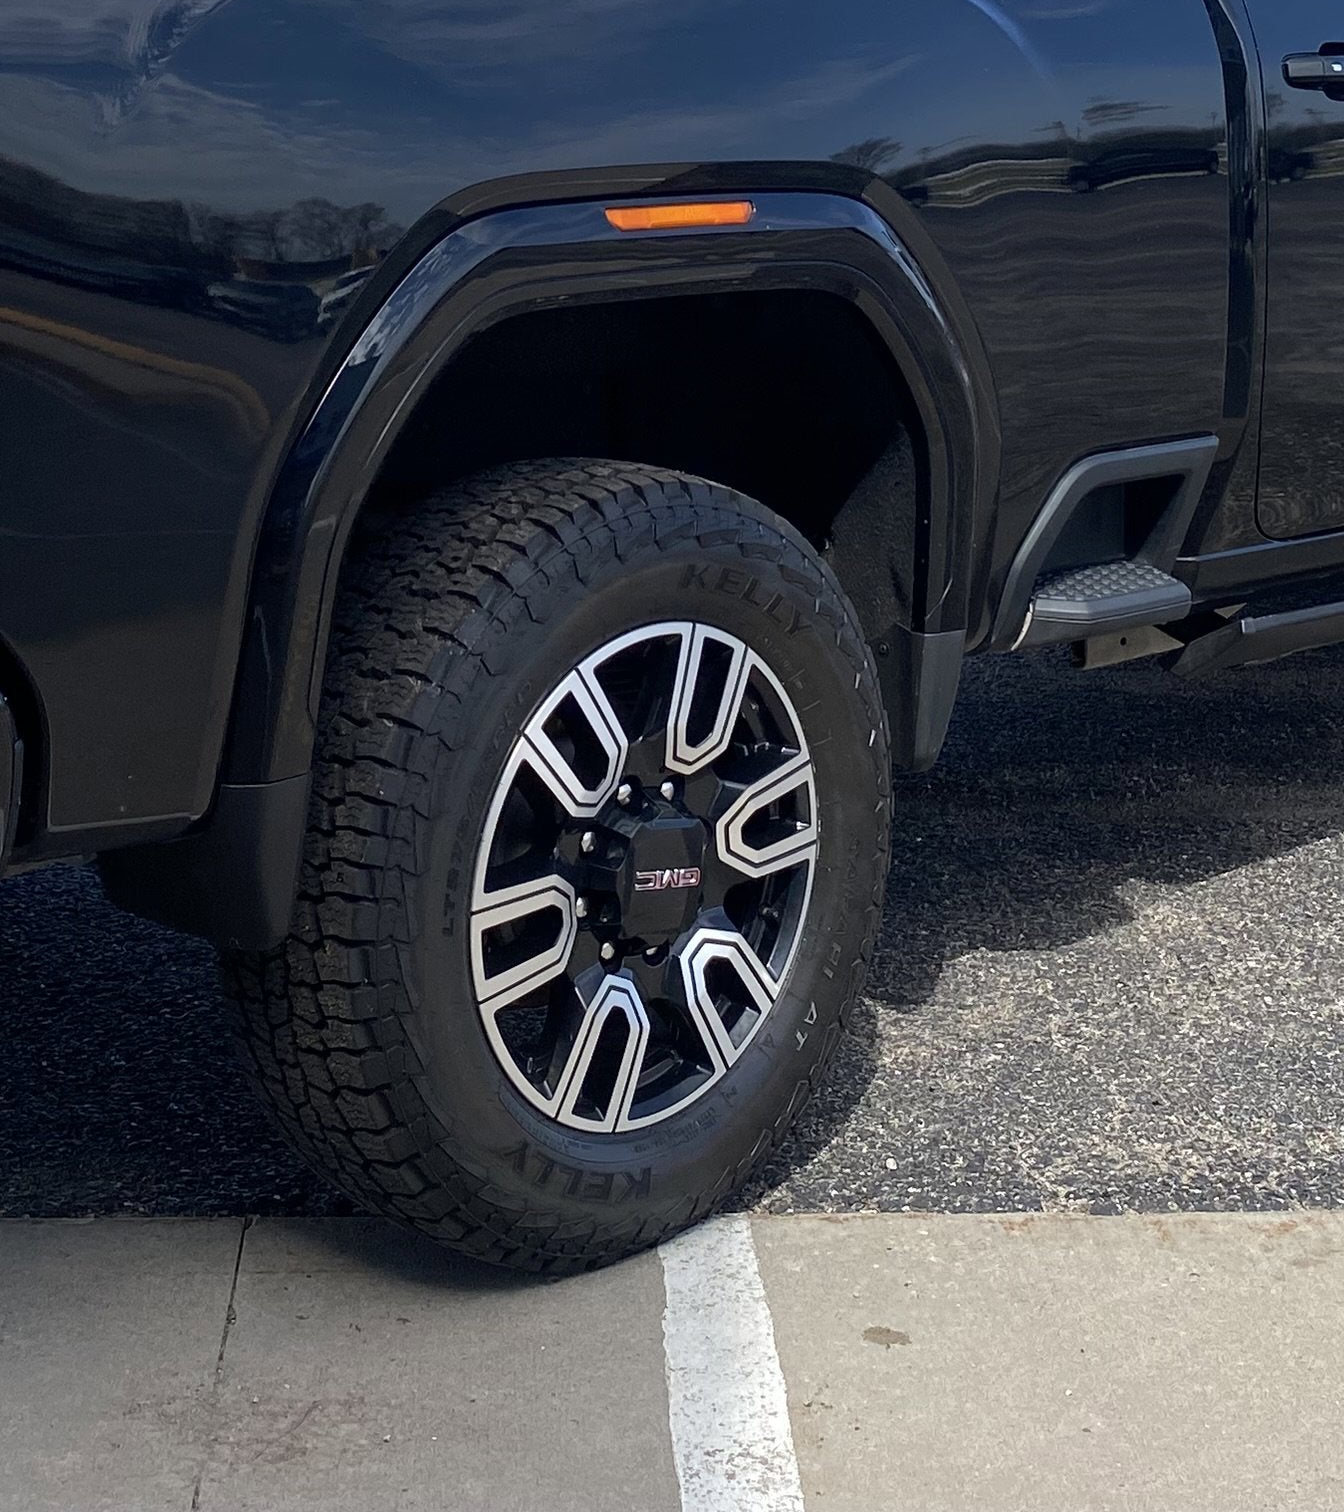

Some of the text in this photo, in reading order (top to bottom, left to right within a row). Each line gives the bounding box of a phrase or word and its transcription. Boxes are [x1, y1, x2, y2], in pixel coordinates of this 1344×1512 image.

[679, 563, 814, 636] KELLY
[634, 867, 701, 891] GMC
[504, 1140, 652, 1203] KELLY
